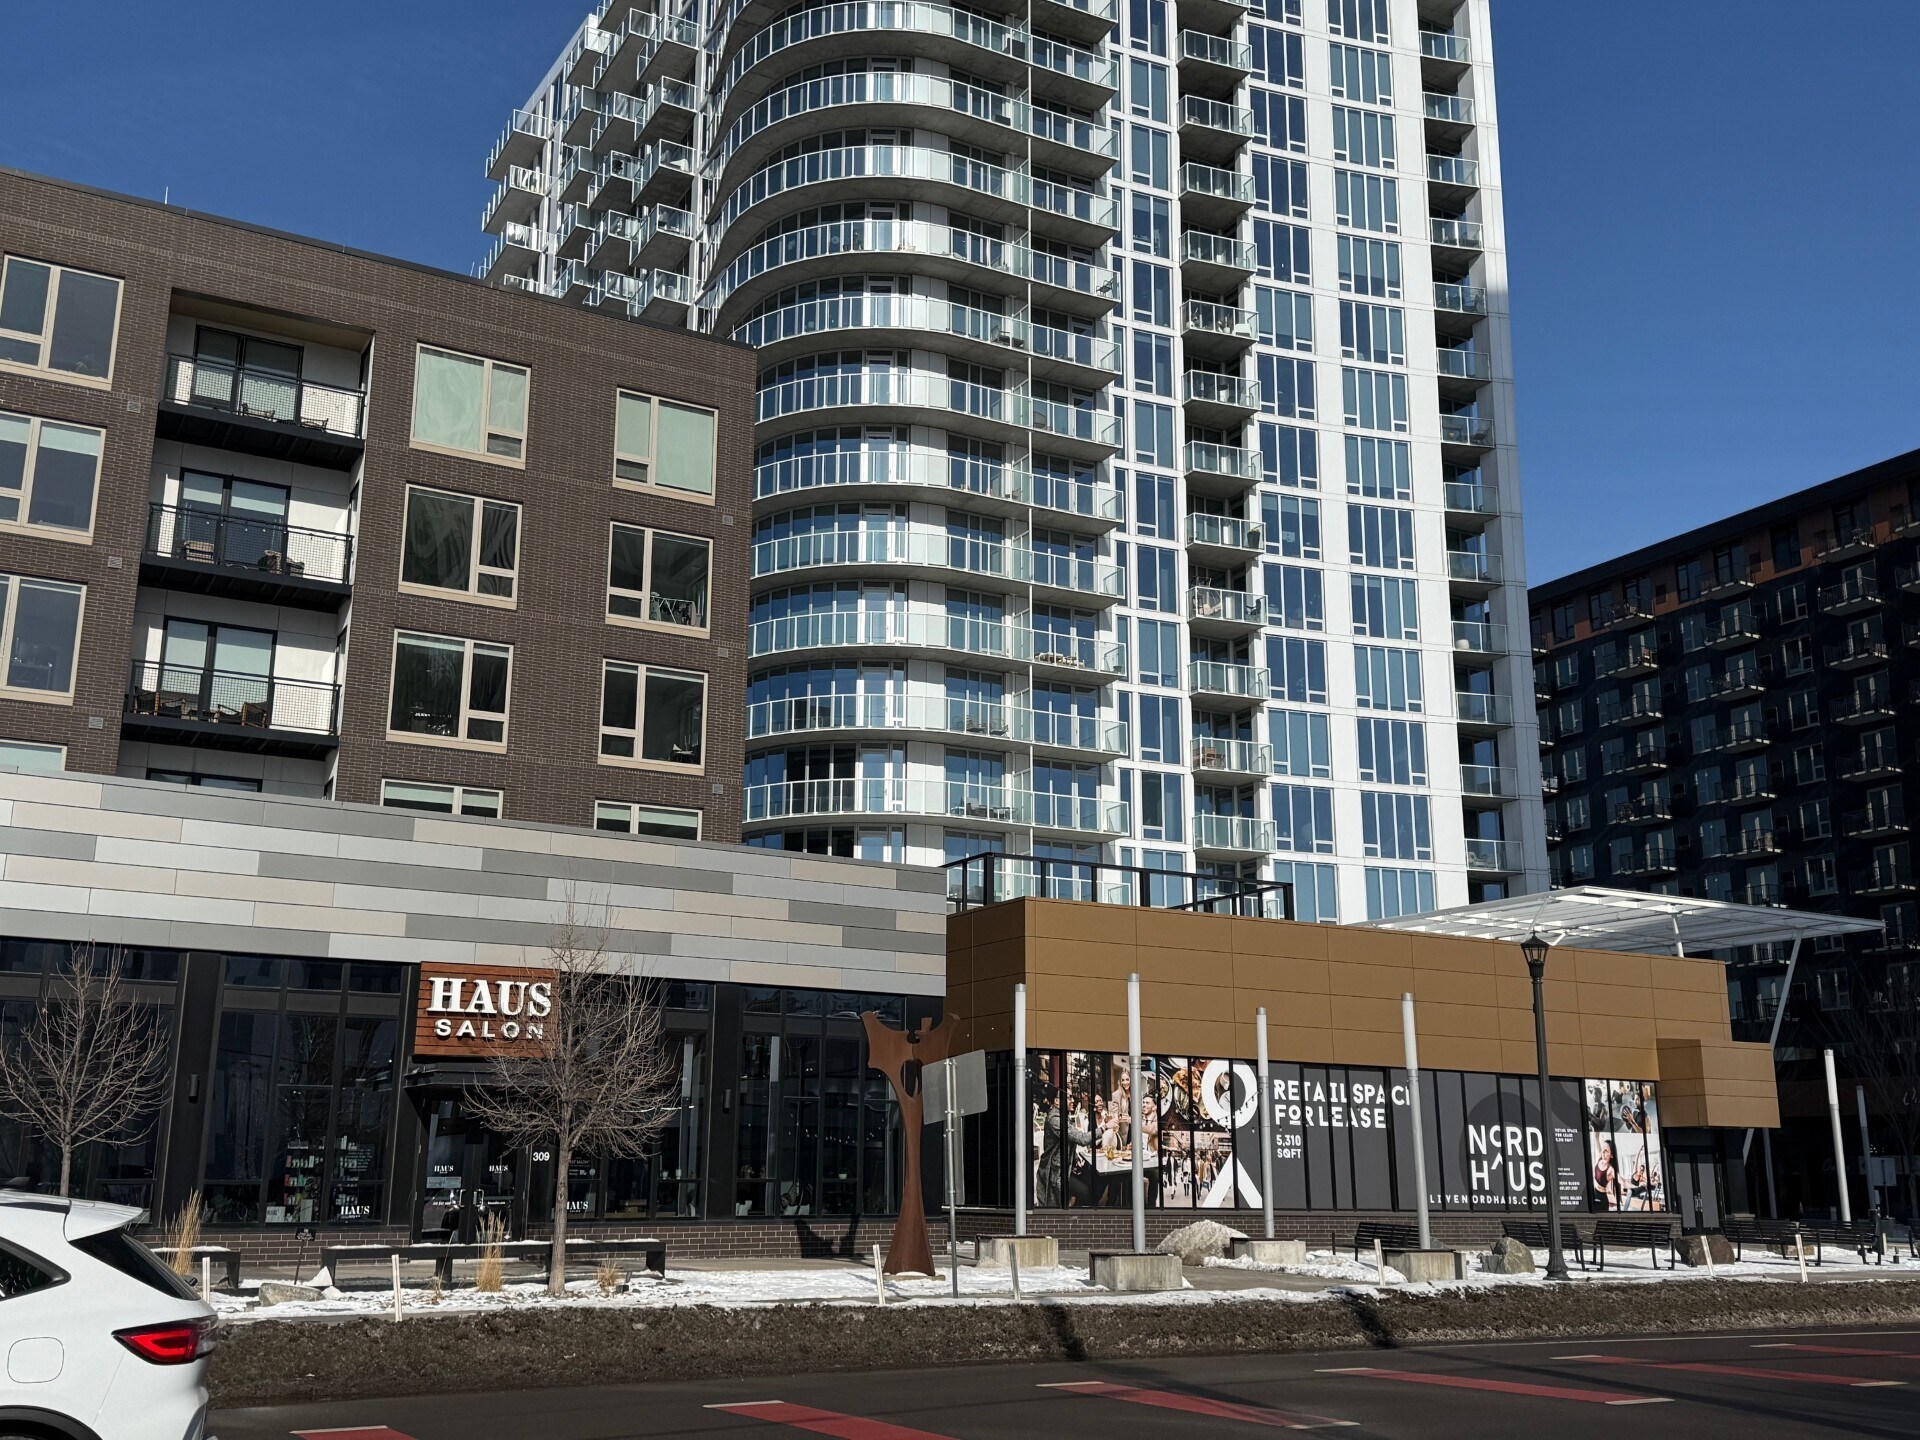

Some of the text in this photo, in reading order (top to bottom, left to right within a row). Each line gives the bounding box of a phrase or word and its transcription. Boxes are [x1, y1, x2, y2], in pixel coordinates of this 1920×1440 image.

[426, 977, 551, 1017] HAUS
[435, 1019, 543, 1040] SALON
[1273, 1079, 1347, 1104] RETAIL
[1275, 1104, 1386, 1129] FOR LEASE
[1276, 1134, 1301, 1147] 5,310
[532, 1151, 550, 1162] 309
[1277, 1149, 1301, 1159] SQFT
[340, 1205, 371, 1215] HAUS
